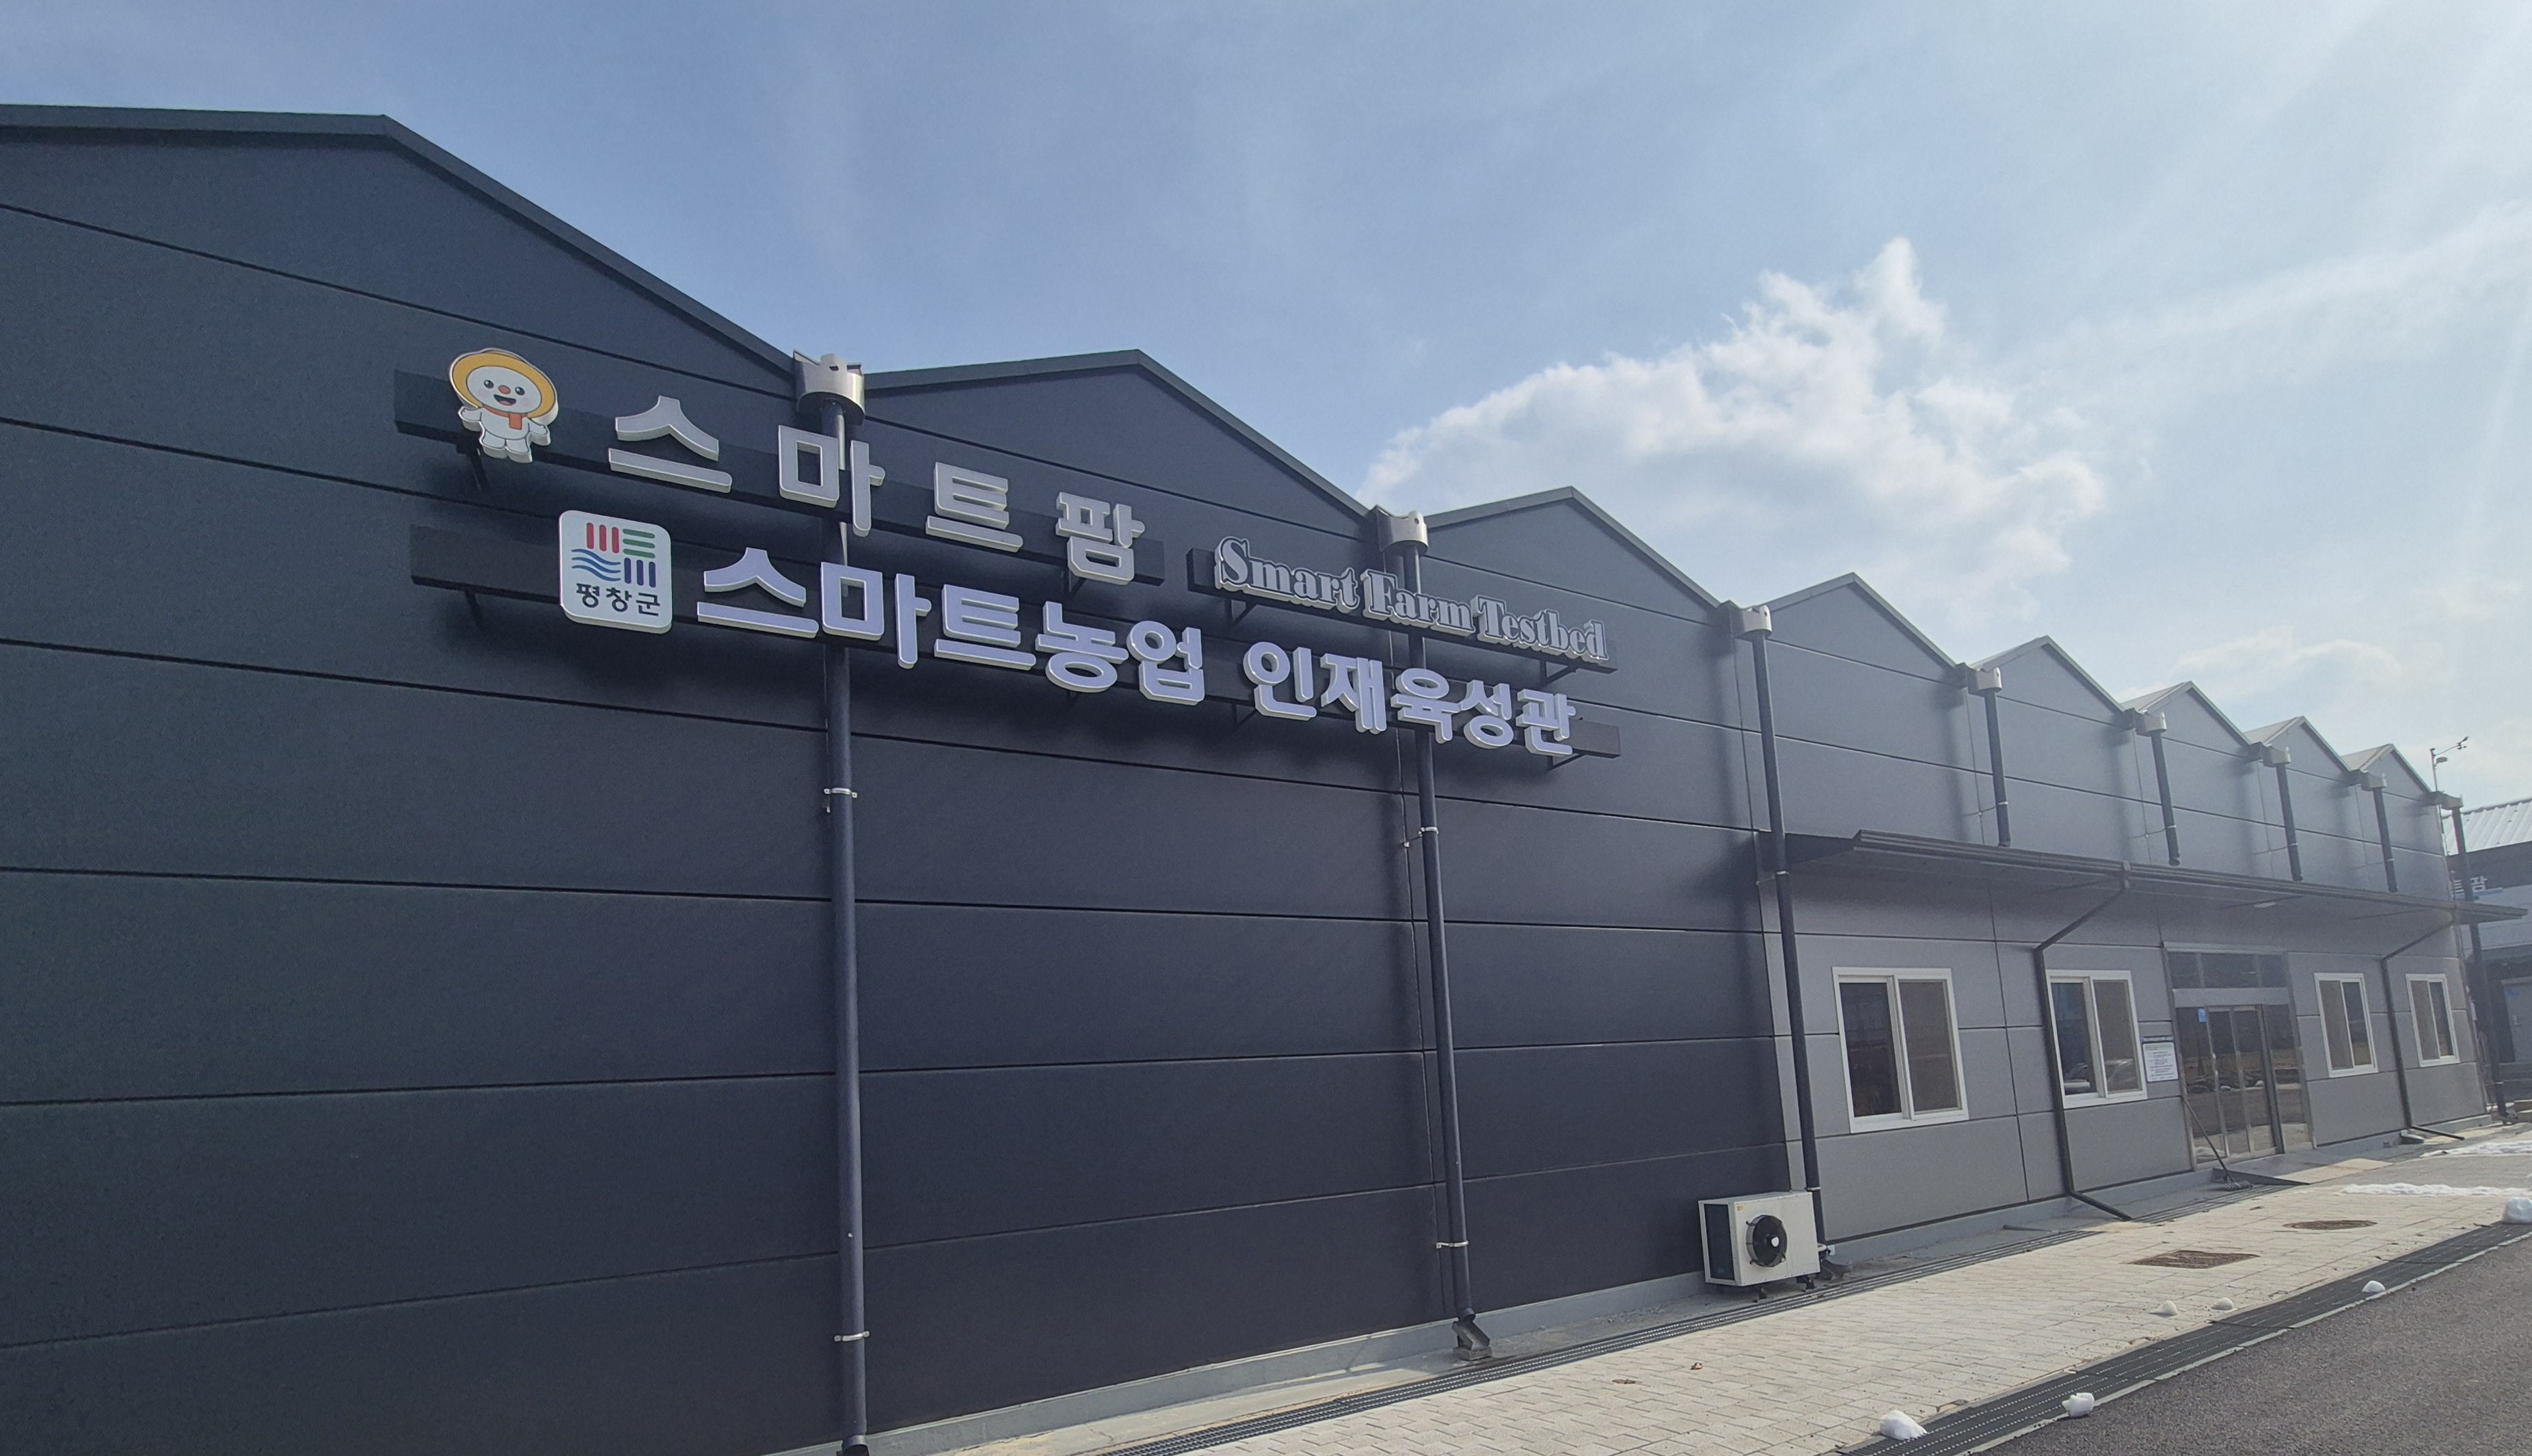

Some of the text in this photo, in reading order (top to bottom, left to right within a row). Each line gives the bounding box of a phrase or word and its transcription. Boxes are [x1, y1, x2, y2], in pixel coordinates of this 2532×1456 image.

[608, 395, 1145, 585] 스마트팜
[576, 582, 660, 617] 평창군
[697, 546, 1576, 757] 스마트농업 인재육성관
[1214, 536, 1608, 664] Smart Farm Testbed
